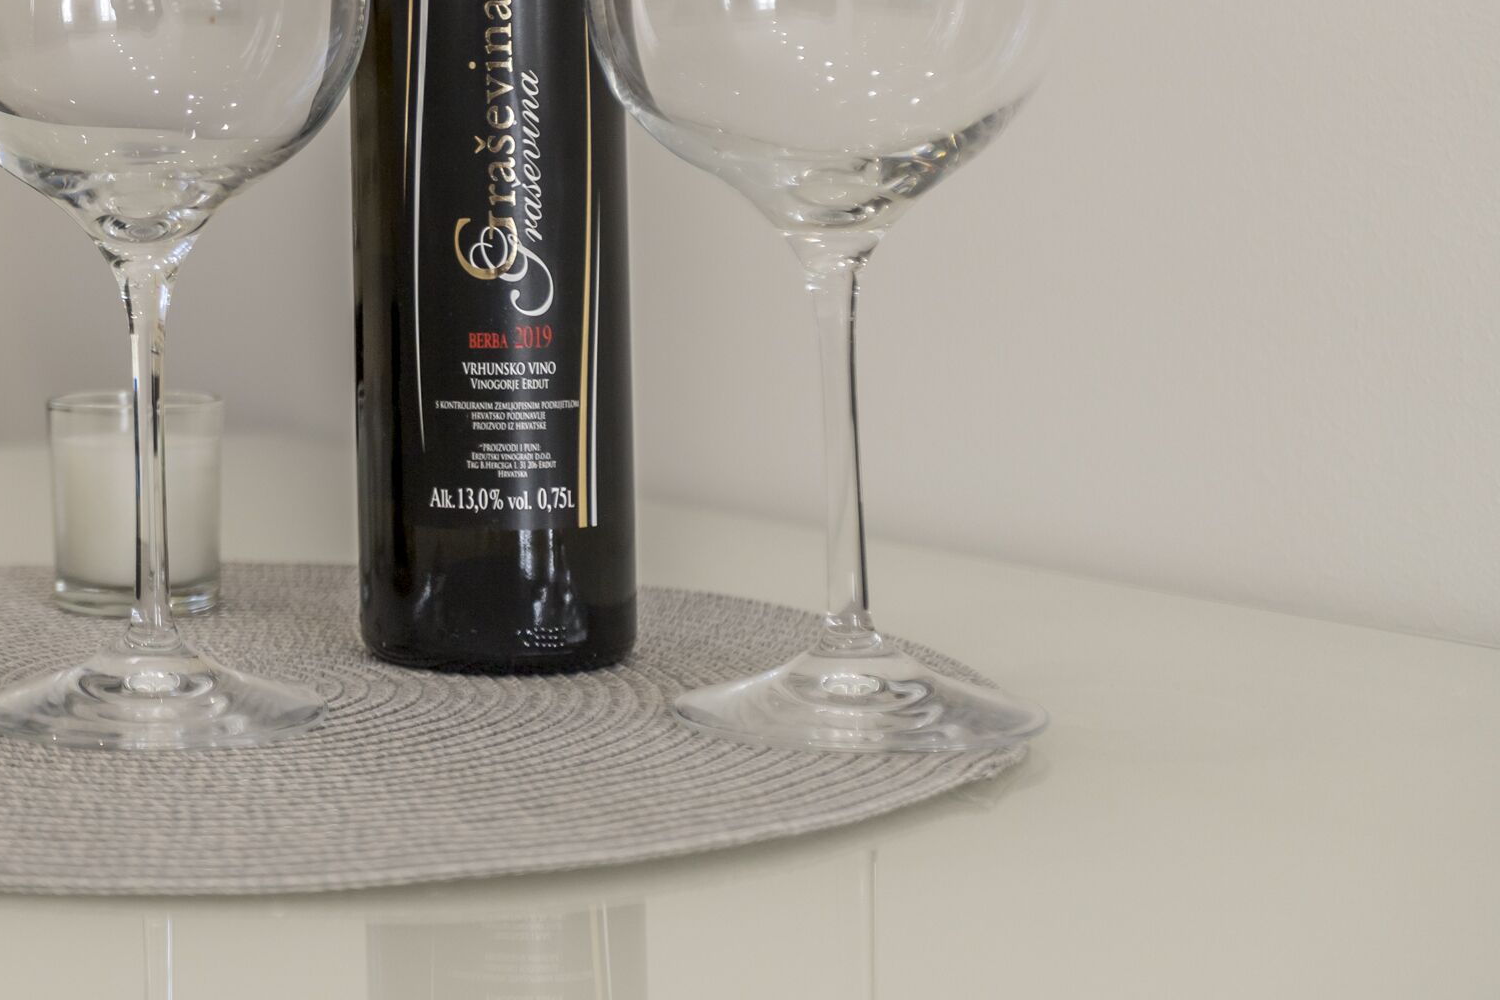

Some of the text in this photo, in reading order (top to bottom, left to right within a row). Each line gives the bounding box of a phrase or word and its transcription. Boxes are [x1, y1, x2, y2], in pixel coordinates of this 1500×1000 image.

[468, 324, 553, 349] BERBA 2019
[461, 361, 557, 376] VRHUNSKO VINO
[470, 377, 550, 392] VINOGORJE ERDUT
[471, 411, 506, 421] HRVATSKO
[472, 421, 547, 431] PROIZVOD IZ HRVATSKE
[429, 486, 456, 509] Alk.
[507, 490, 533, 511] vol.
